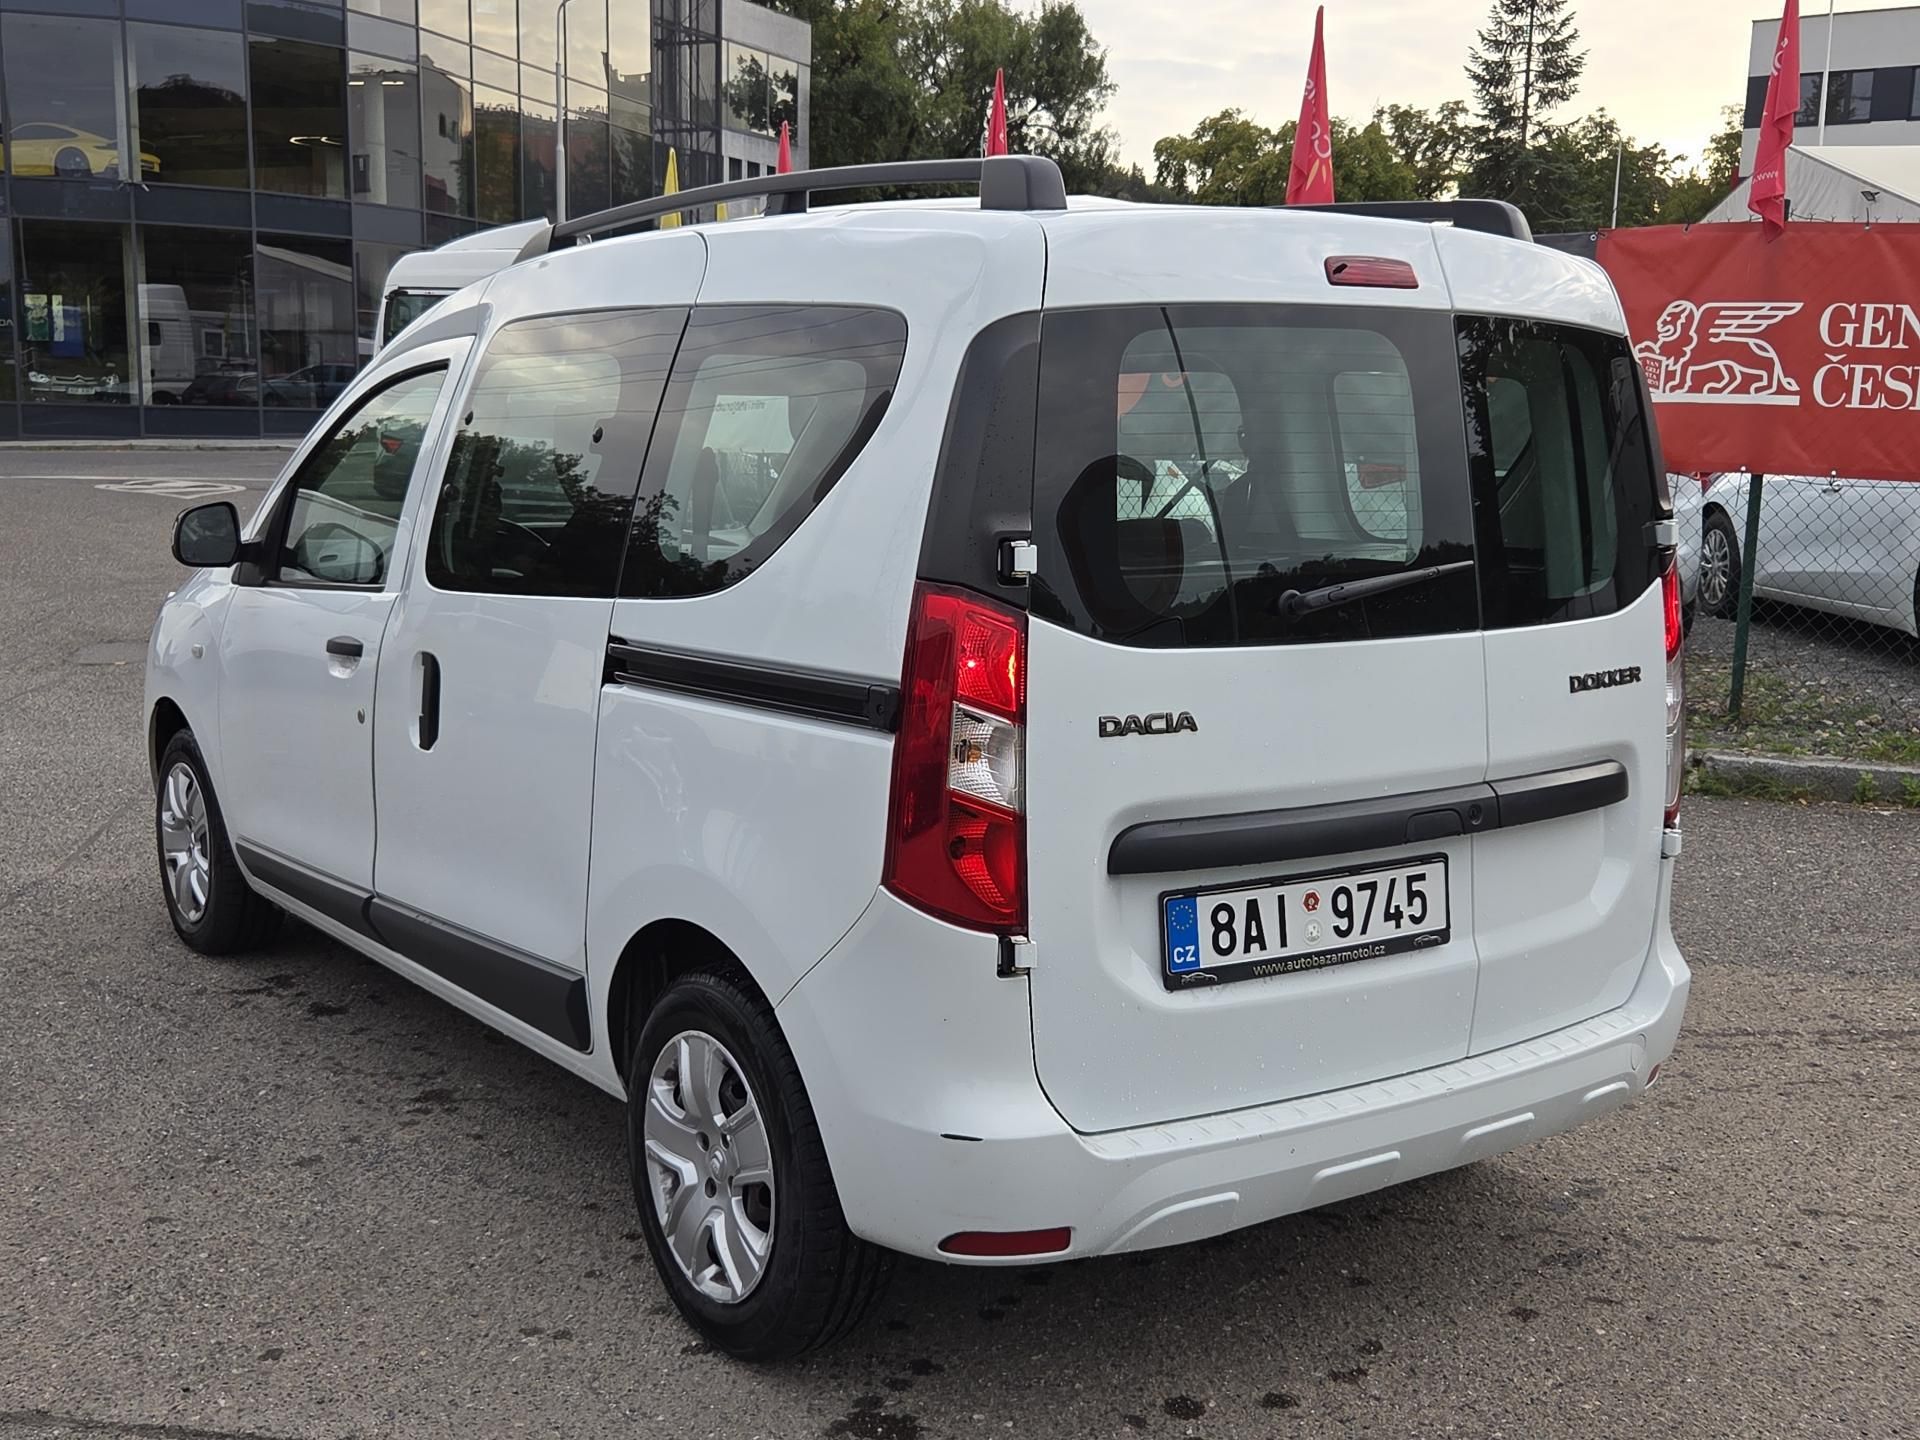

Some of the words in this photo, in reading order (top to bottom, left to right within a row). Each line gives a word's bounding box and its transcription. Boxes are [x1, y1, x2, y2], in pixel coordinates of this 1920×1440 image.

[1569, 666, 1641, 693] DOKKER
[1099, 711, 1198, 737] DACIA
[1210, 894, 1288, 957] 8AI
[1331, 872, 1427, 938] 9745
[1173, 945, 1196, 964] CZ
[1253, 943, 1386, 976] www.autobazarmotol.cz
